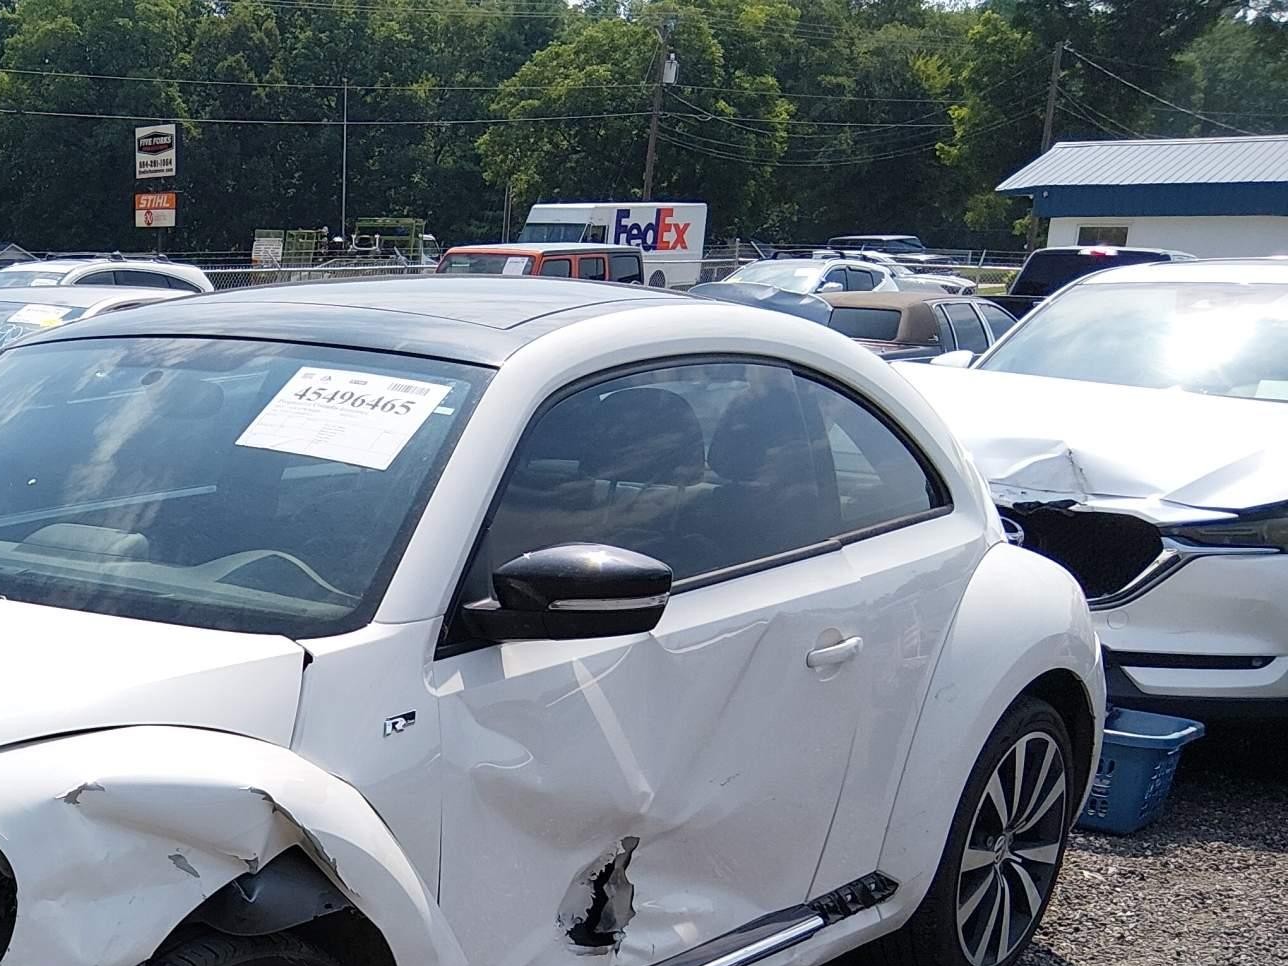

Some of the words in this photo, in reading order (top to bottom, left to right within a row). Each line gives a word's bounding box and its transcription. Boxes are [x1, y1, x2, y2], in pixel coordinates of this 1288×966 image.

[139, 195, 170, 208] STIHL
[614, 208, 691, 252] FedEx
[293, 386, 416, 416] 45496465
